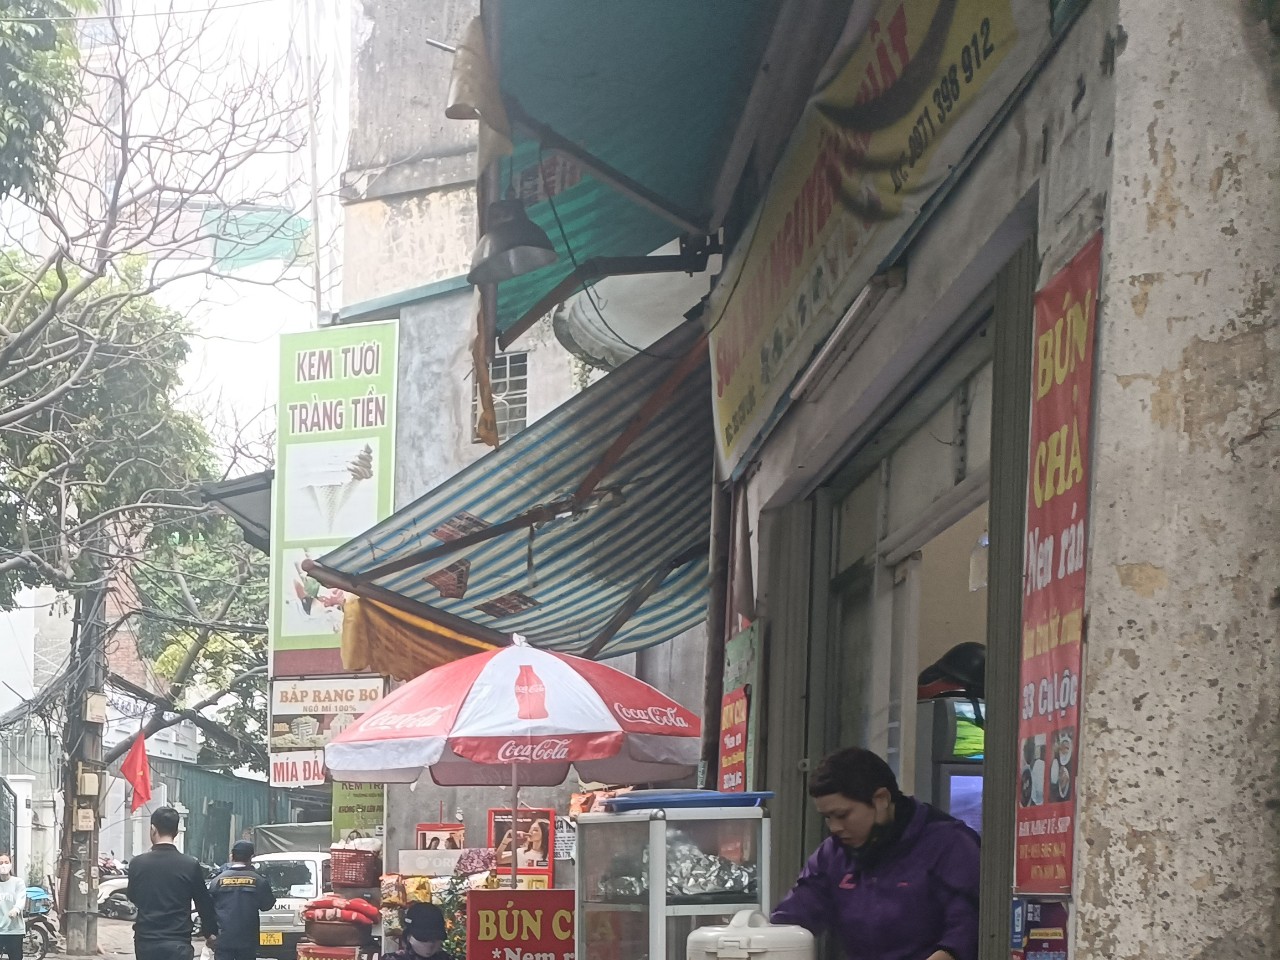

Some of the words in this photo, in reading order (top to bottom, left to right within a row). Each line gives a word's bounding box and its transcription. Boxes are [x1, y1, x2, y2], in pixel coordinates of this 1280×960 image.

[933, 63, 960, 124] 398
[961, 17, 995, 84] 912
[1037, 288, 1092, 400] BÚN
[297, 349, 333, 382] KEM
[341, 341, 380, 377] TƯƠI
[288, 394, 343, 434] TRÀNG
[351, 386, 386, 428] TIỀN
[312, 689, 355, 703] RANG
[359, 686, 380, 701] BƠ
[335, 704, 356, 712] 100%
[614, 703, 689, 729] Coca-Cola
[497, 739, 571, 762] Coca-Cola
[273, 756, 298, 783] MÍA
[477, 900, 544, 941] BÚN
